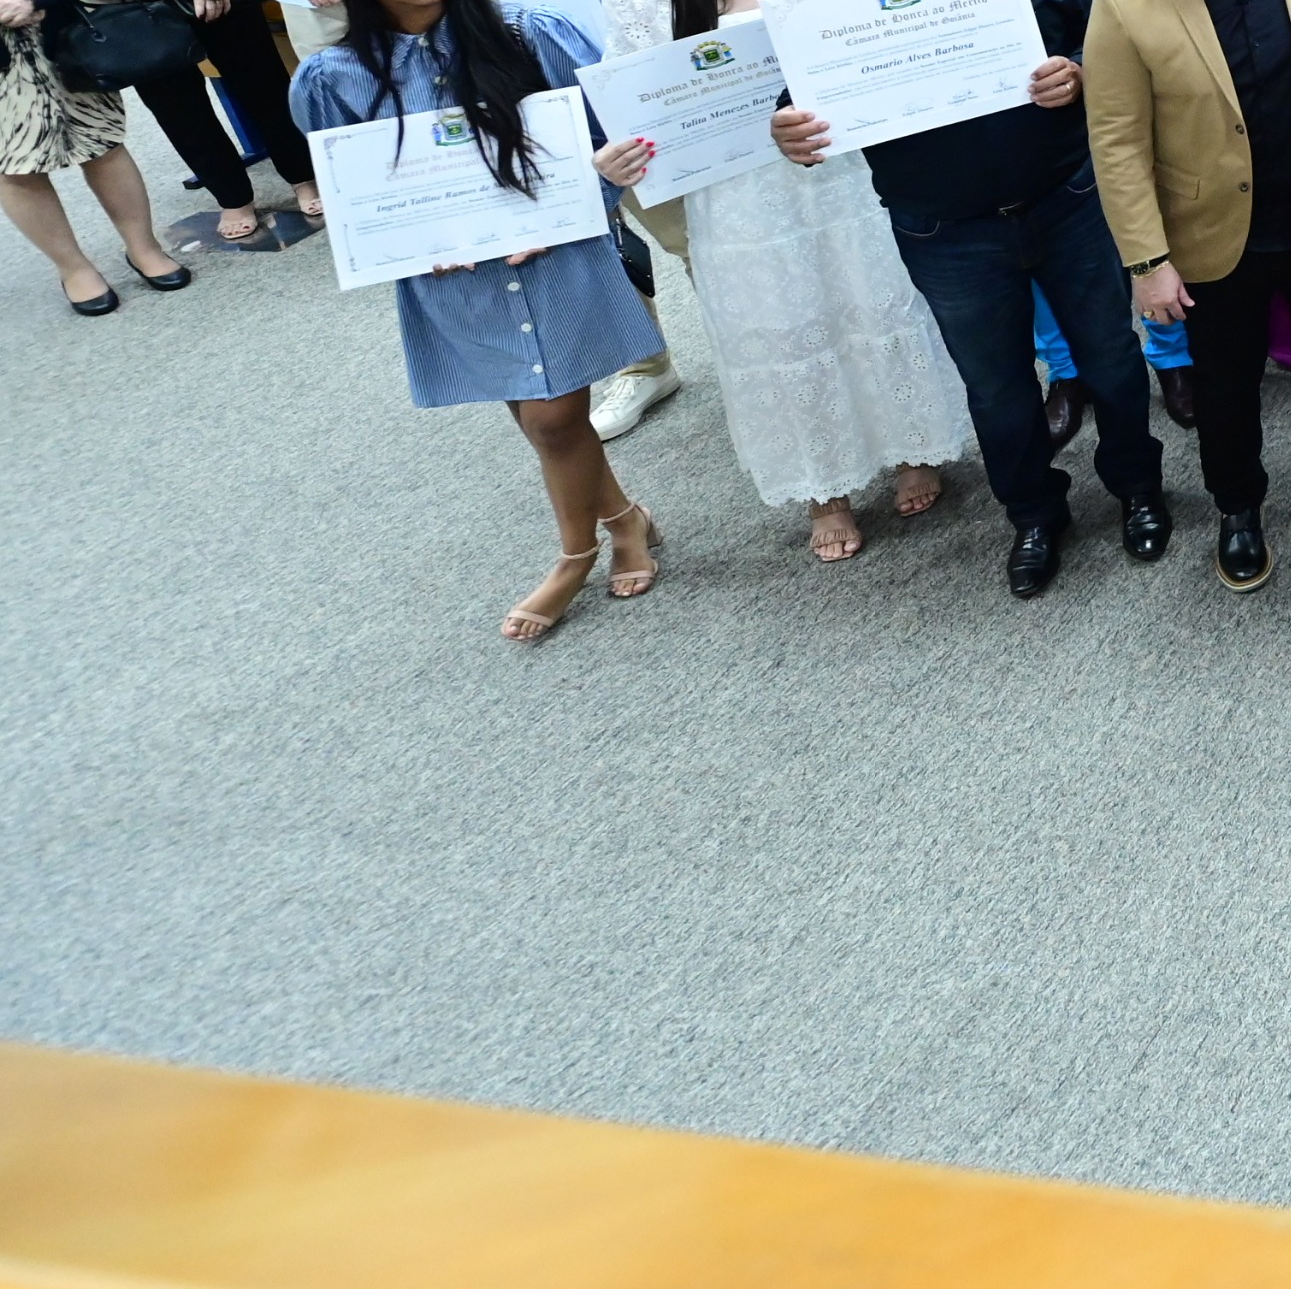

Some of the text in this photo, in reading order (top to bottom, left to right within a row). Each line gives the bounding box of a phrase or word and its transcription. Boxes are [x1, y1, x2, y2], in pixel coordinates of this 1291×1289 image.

[818, 20, 872, 40] Diploma
[874, 16, 887, 28] de
[891, 9, 928, 24] Honra
[933, 3, 946, 15] ao
[845, 11, 976, 47] Câmara Municipal de Goiânia
[861, 40, 974, 75] Osmario Alves Barbosa
[637, 82, 688, 104] Diploma
[690, 77, 703, 87] de
[705, 66, 744, 83] Honra
[747, 61, 759, 72] ao
[664, 67, 782, 106] Câmara Municipal de Goiân
[680, 93, 781, 130] Talita Menezes Barbo
[384, 156, 429, 170] Dploma
[377, 185, 491, 214] Ingrid Talline Ramos de
